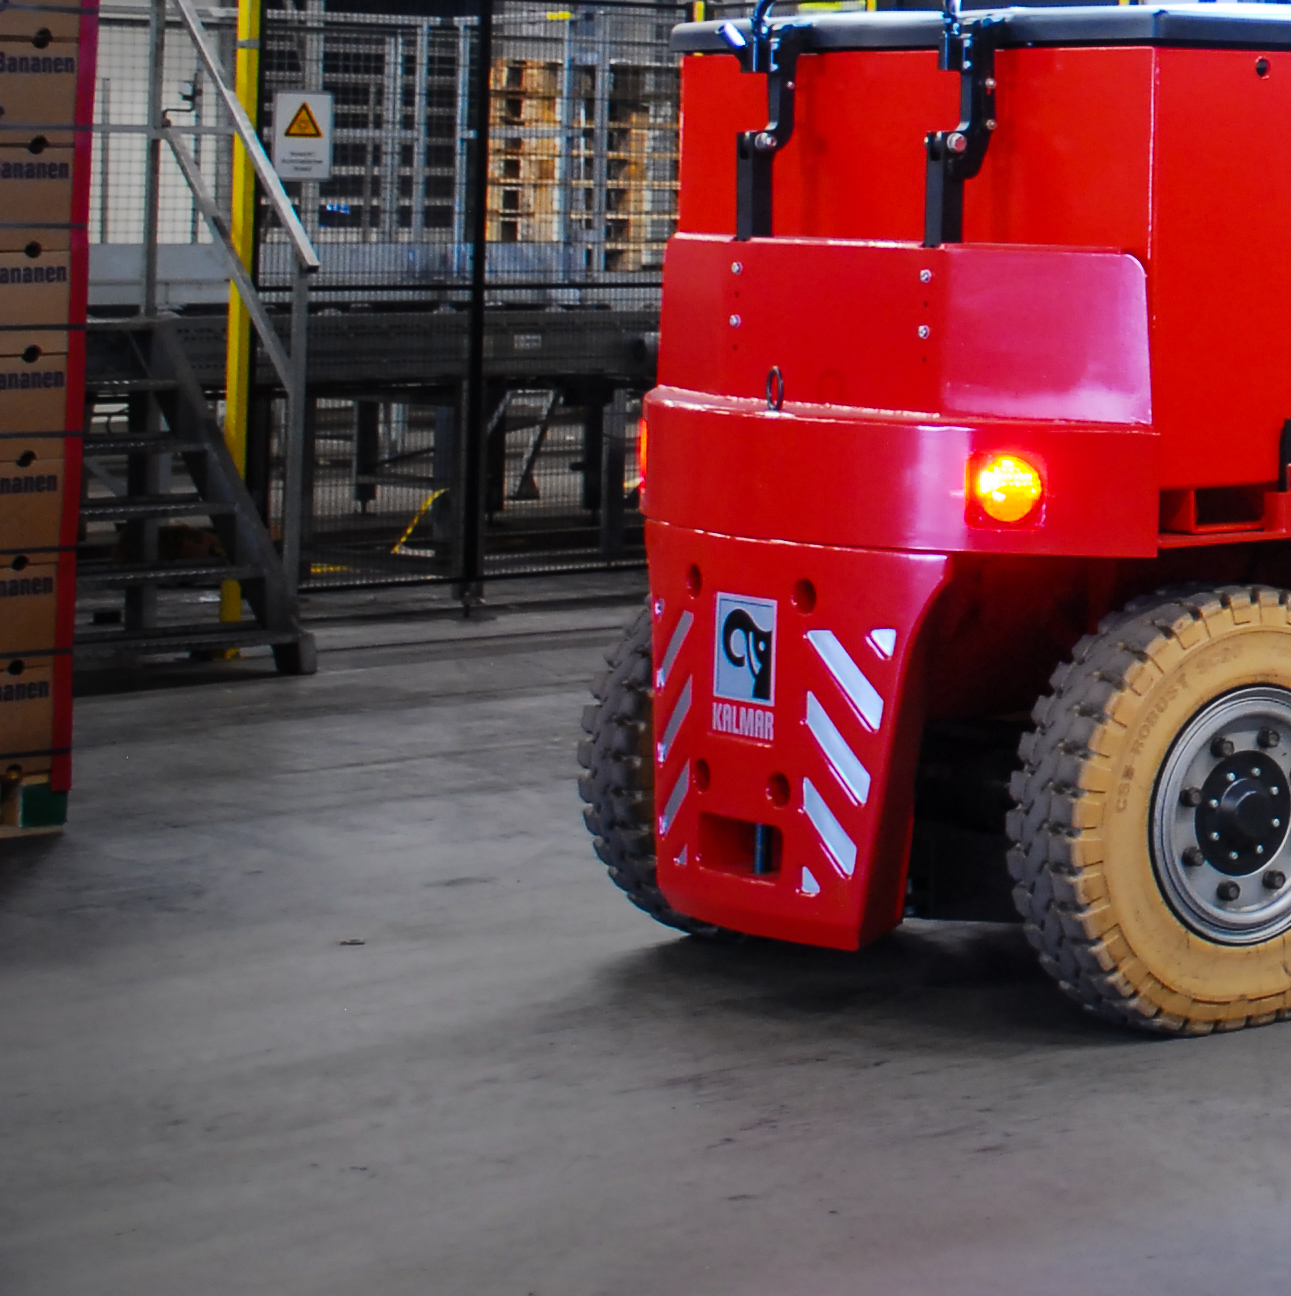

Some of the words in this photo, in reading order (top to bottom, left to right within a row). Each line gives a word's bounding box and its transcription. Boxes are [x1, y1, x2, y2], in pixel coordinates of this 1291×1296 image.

[0, 161, 69, 180] ananen
[0, 265, 67, 284] ananen
[0, 370, 65, 389] ananen
[0, 474, 58, 493] nanen
[0, 576, 53, 596] nanen
[712, 701, 775, 741] KALMAR
